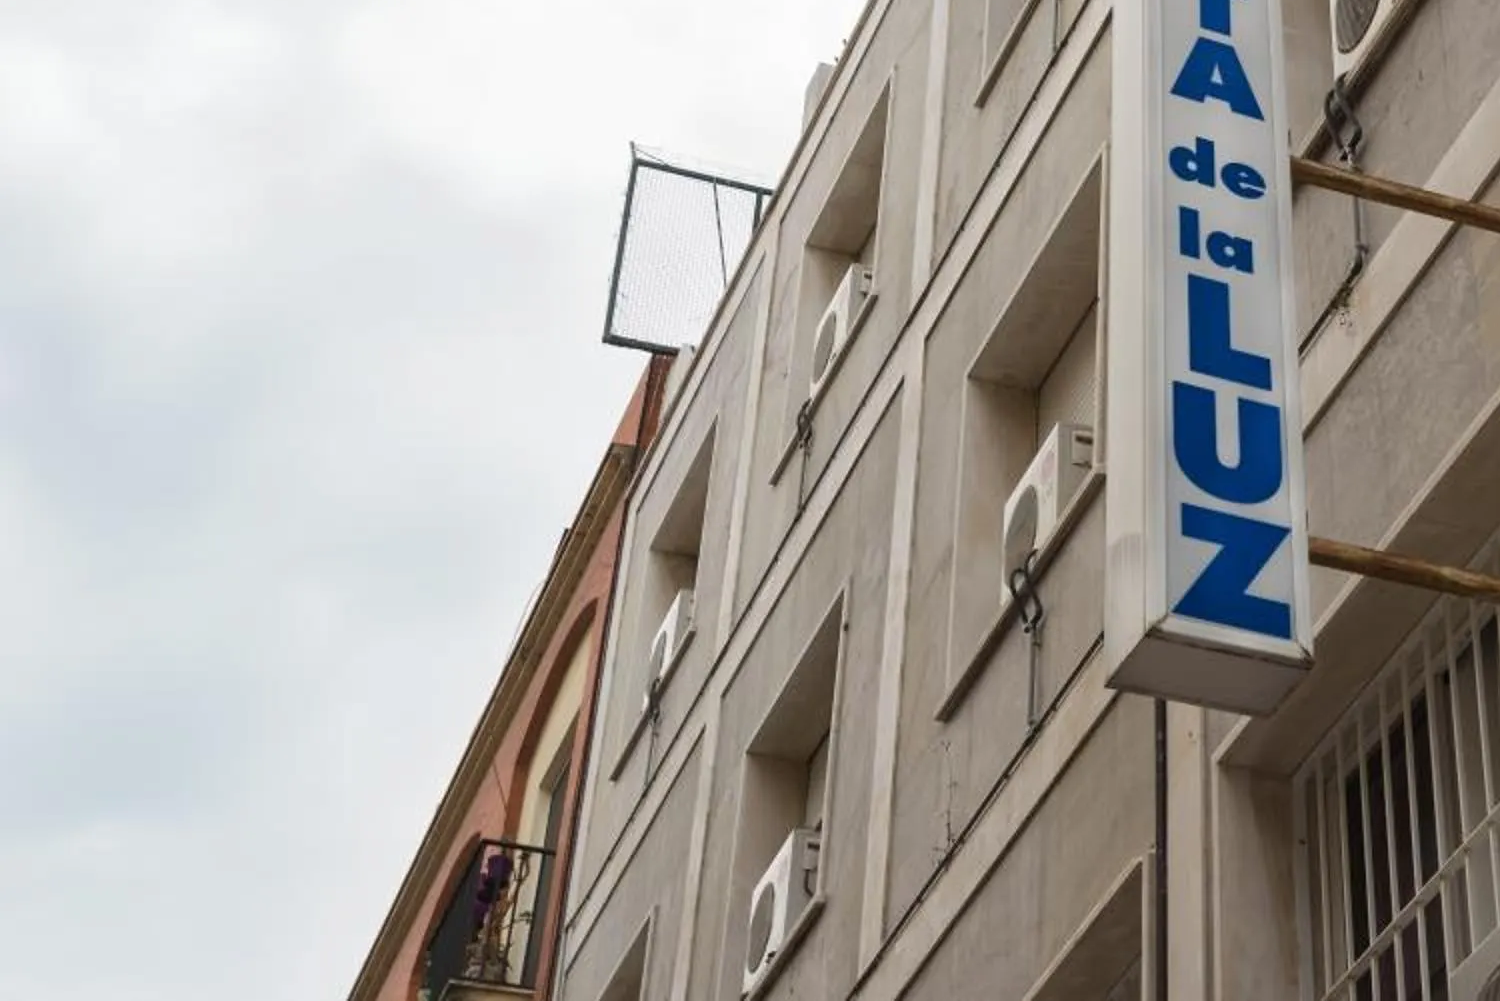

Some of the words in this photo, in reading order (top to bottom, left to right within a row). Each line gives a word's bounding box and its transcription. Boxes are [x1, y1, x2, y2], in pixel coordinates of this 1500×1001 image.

[1169, 136, 1266, 199] de
[1179, 206, 1254, 274] la
[1172, 273, 1292, 639] LUZ
